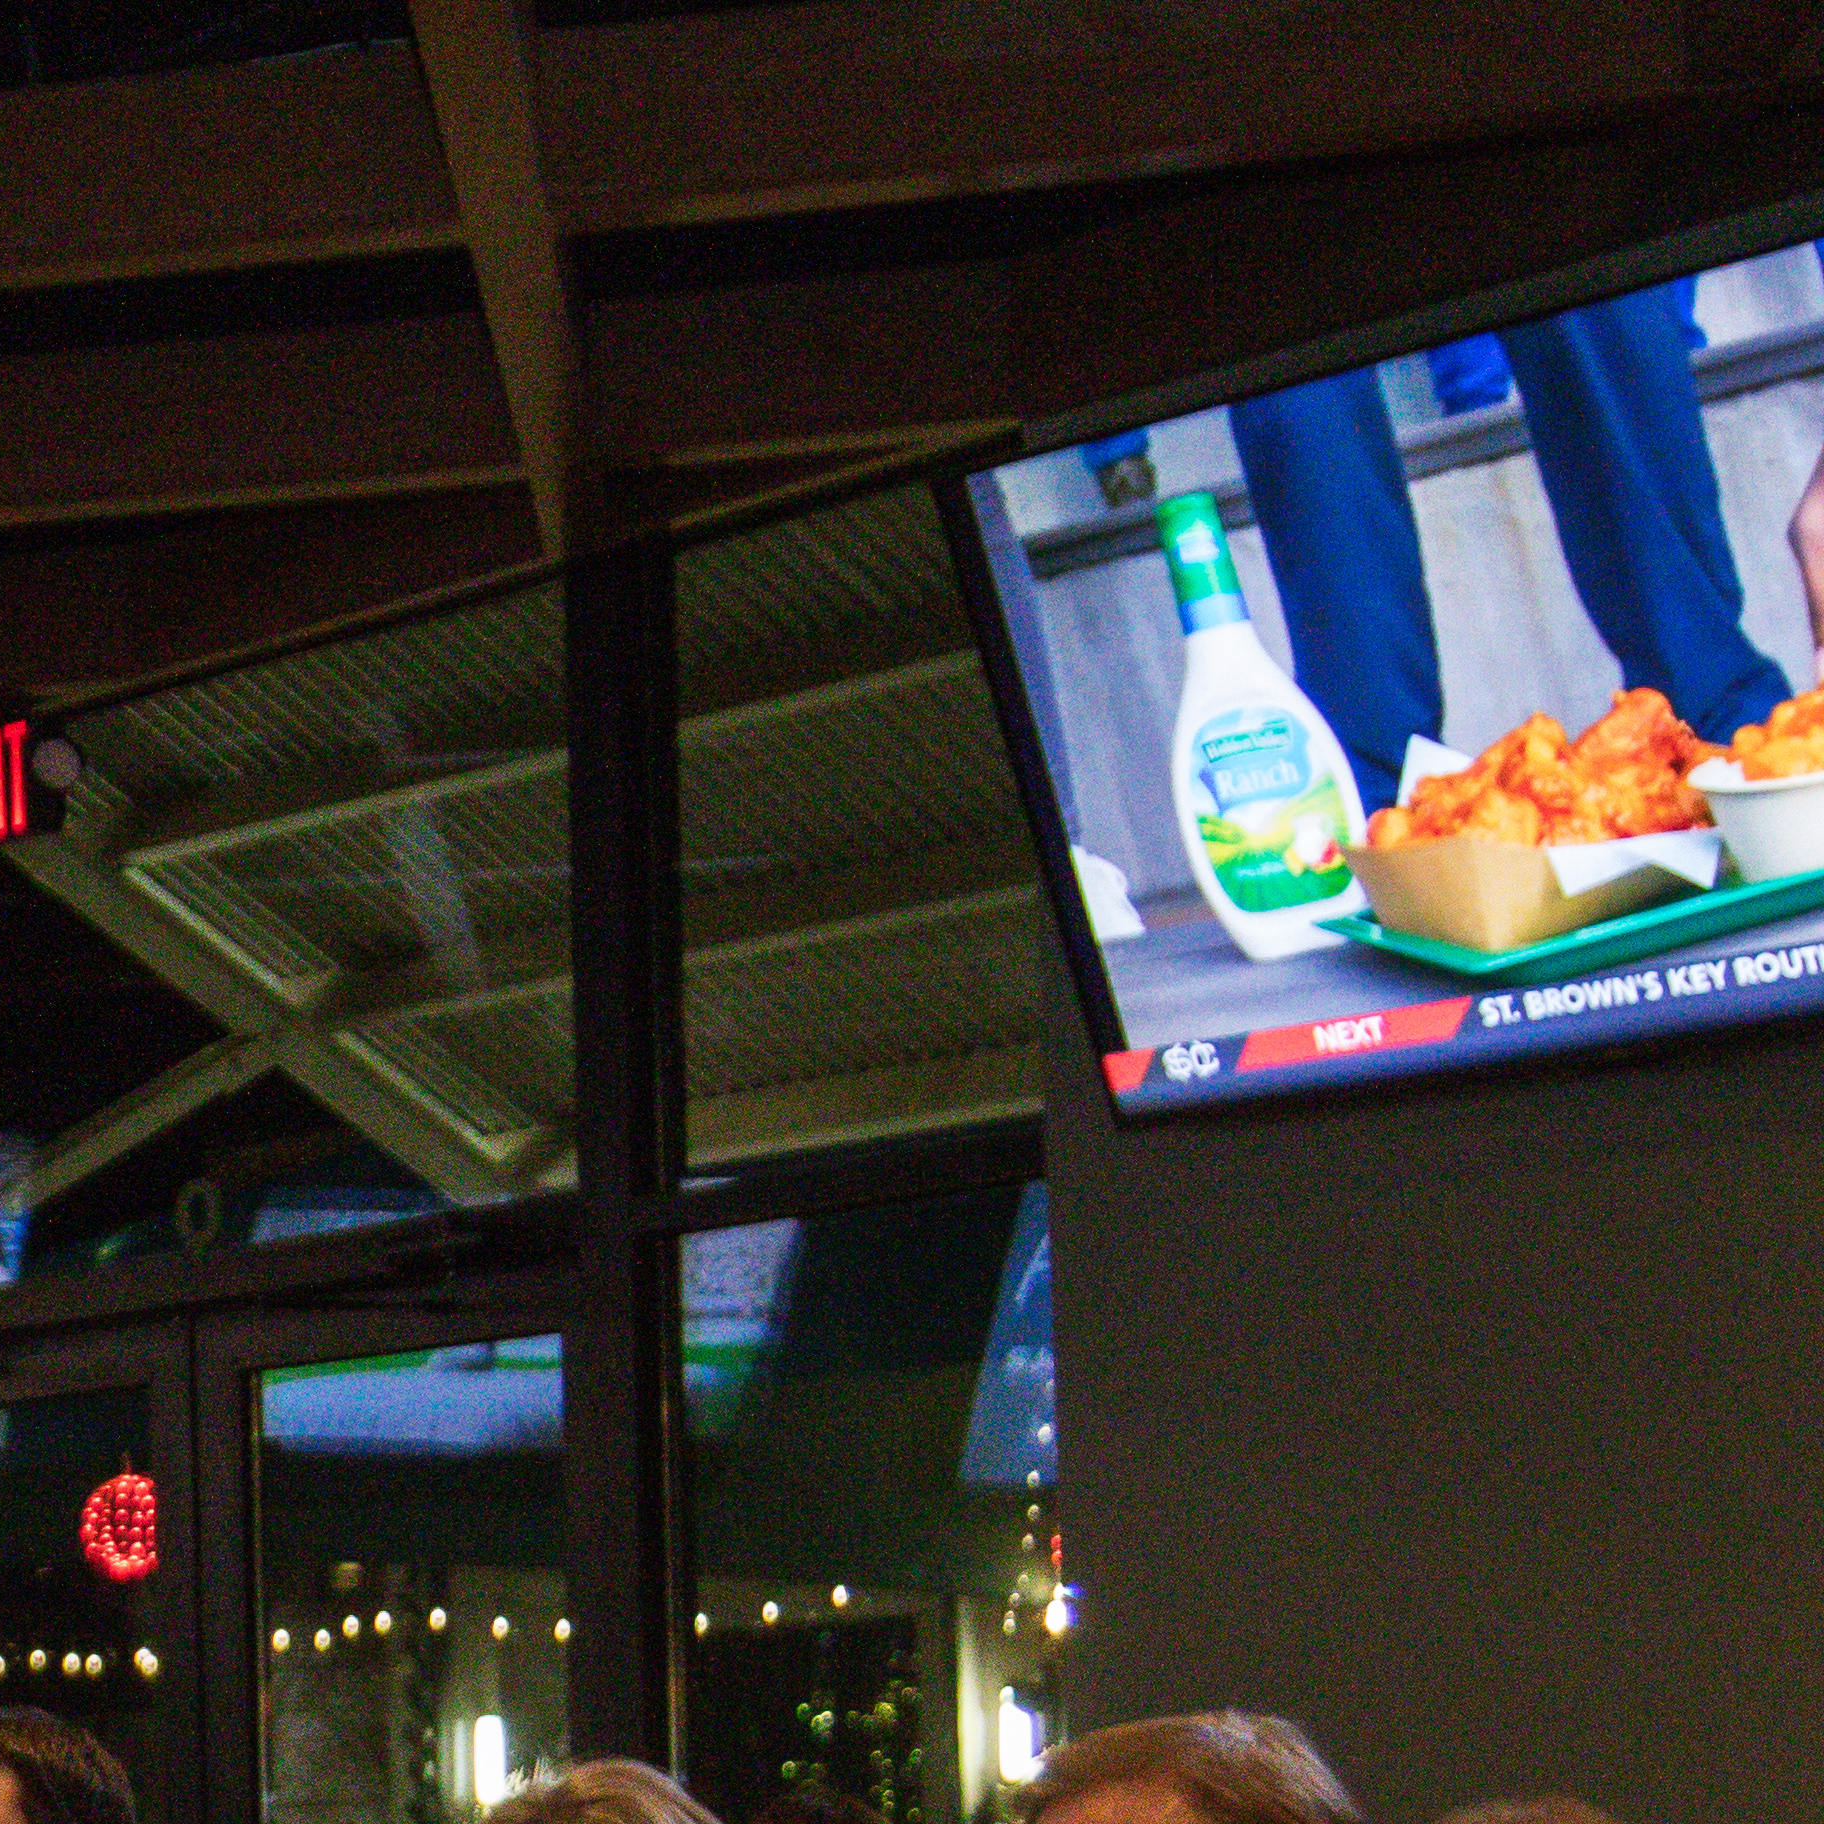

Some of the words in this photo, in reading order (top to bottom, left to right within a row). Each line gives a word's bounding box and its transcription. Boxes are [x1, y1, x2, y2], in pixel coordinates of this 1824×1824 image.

[1215, 758, 1300, 799] Ranch
[1312, 1015, 1384, 1055] NEXT
[1477, 994, 1522, 1028] ST.
[1522, 970, 1665, 1021] BROWN'S
[1666, 958, 1727, 999] KEY
